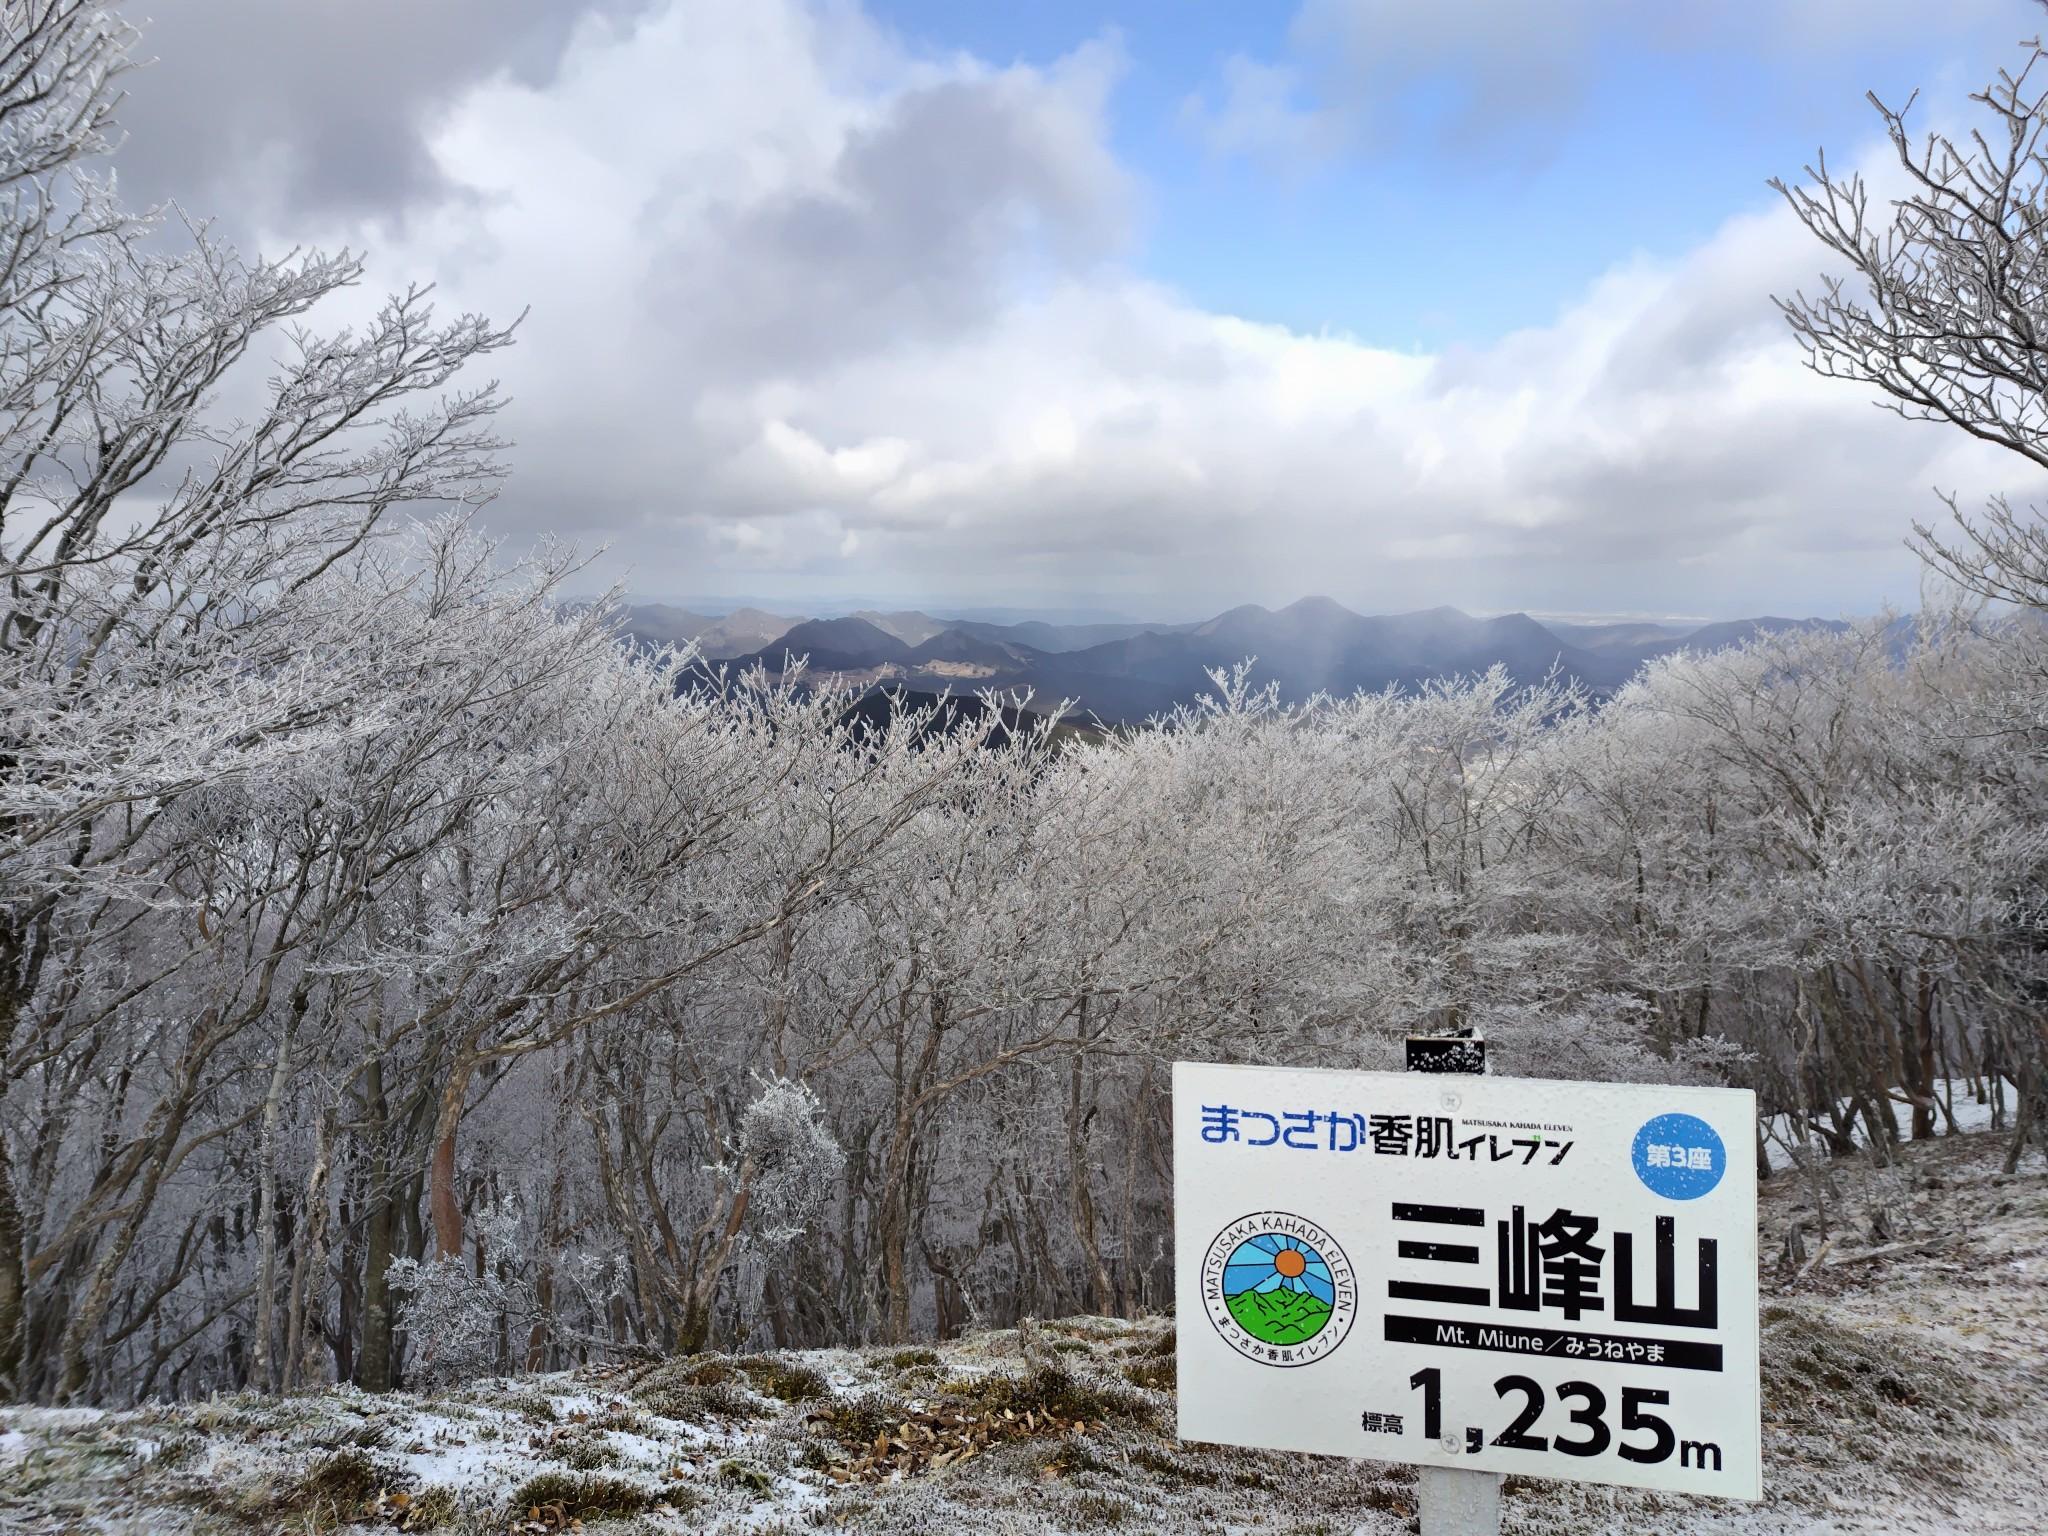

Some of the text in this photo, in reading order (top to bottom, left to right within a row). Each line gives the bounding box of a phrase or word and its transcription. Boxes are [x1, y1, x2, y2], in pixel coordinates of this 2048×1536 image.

[1461, 1118, 1573, 1132] MATSUSAKA KAHADA ELEVEN
[1646, 1143, 1712, 1171] 第3座
[1206, 1216, 1353, 1312] MATSUSAKA KAHADA ELEVEN
[1388, 1202, 1718, 1330] 三峰山
[1435, 1324, 1470, 1345] Mt.
[1361, 1410, 1404, 1435] 標高
